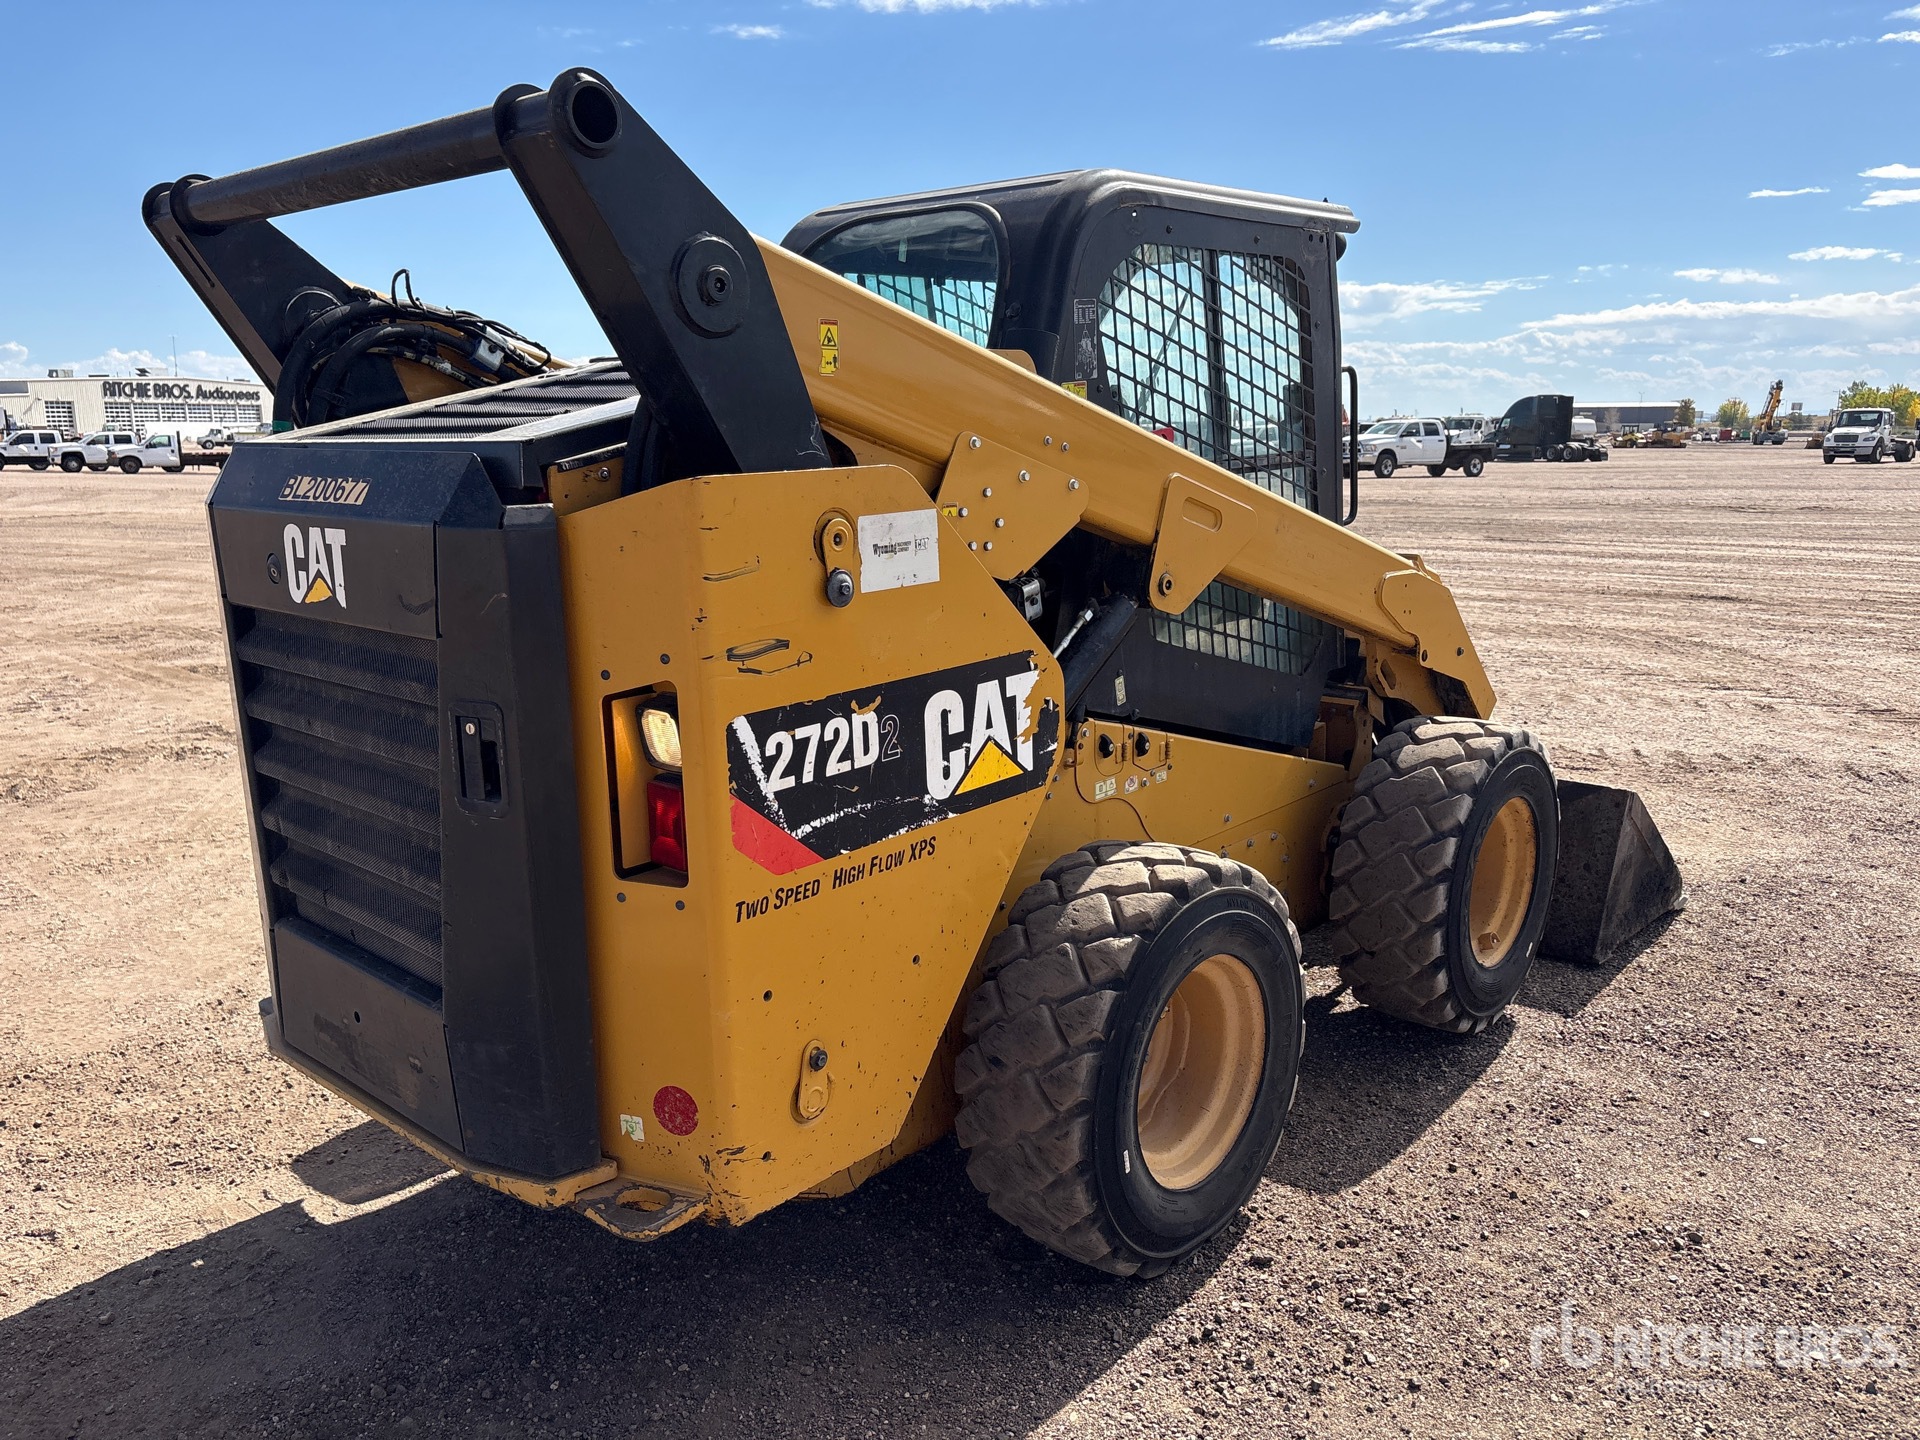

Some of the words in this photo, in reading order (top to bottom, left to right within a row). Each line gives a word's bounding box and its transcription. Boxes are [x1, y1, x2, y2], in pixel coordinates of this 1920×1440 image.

[102, 381, 151, 397] RITCHIE
[153, 383, 194, 399] BROS.
[196, 386, 260, 400] Auctioneers
[280, 475, 371, 503] BL200677
[872, 542, 897, 557] Wyoming
[284, 523, 347, 609] CAT
[924, 670, 1040, 800] CAT
[908, 836, 936, 863] XPS
